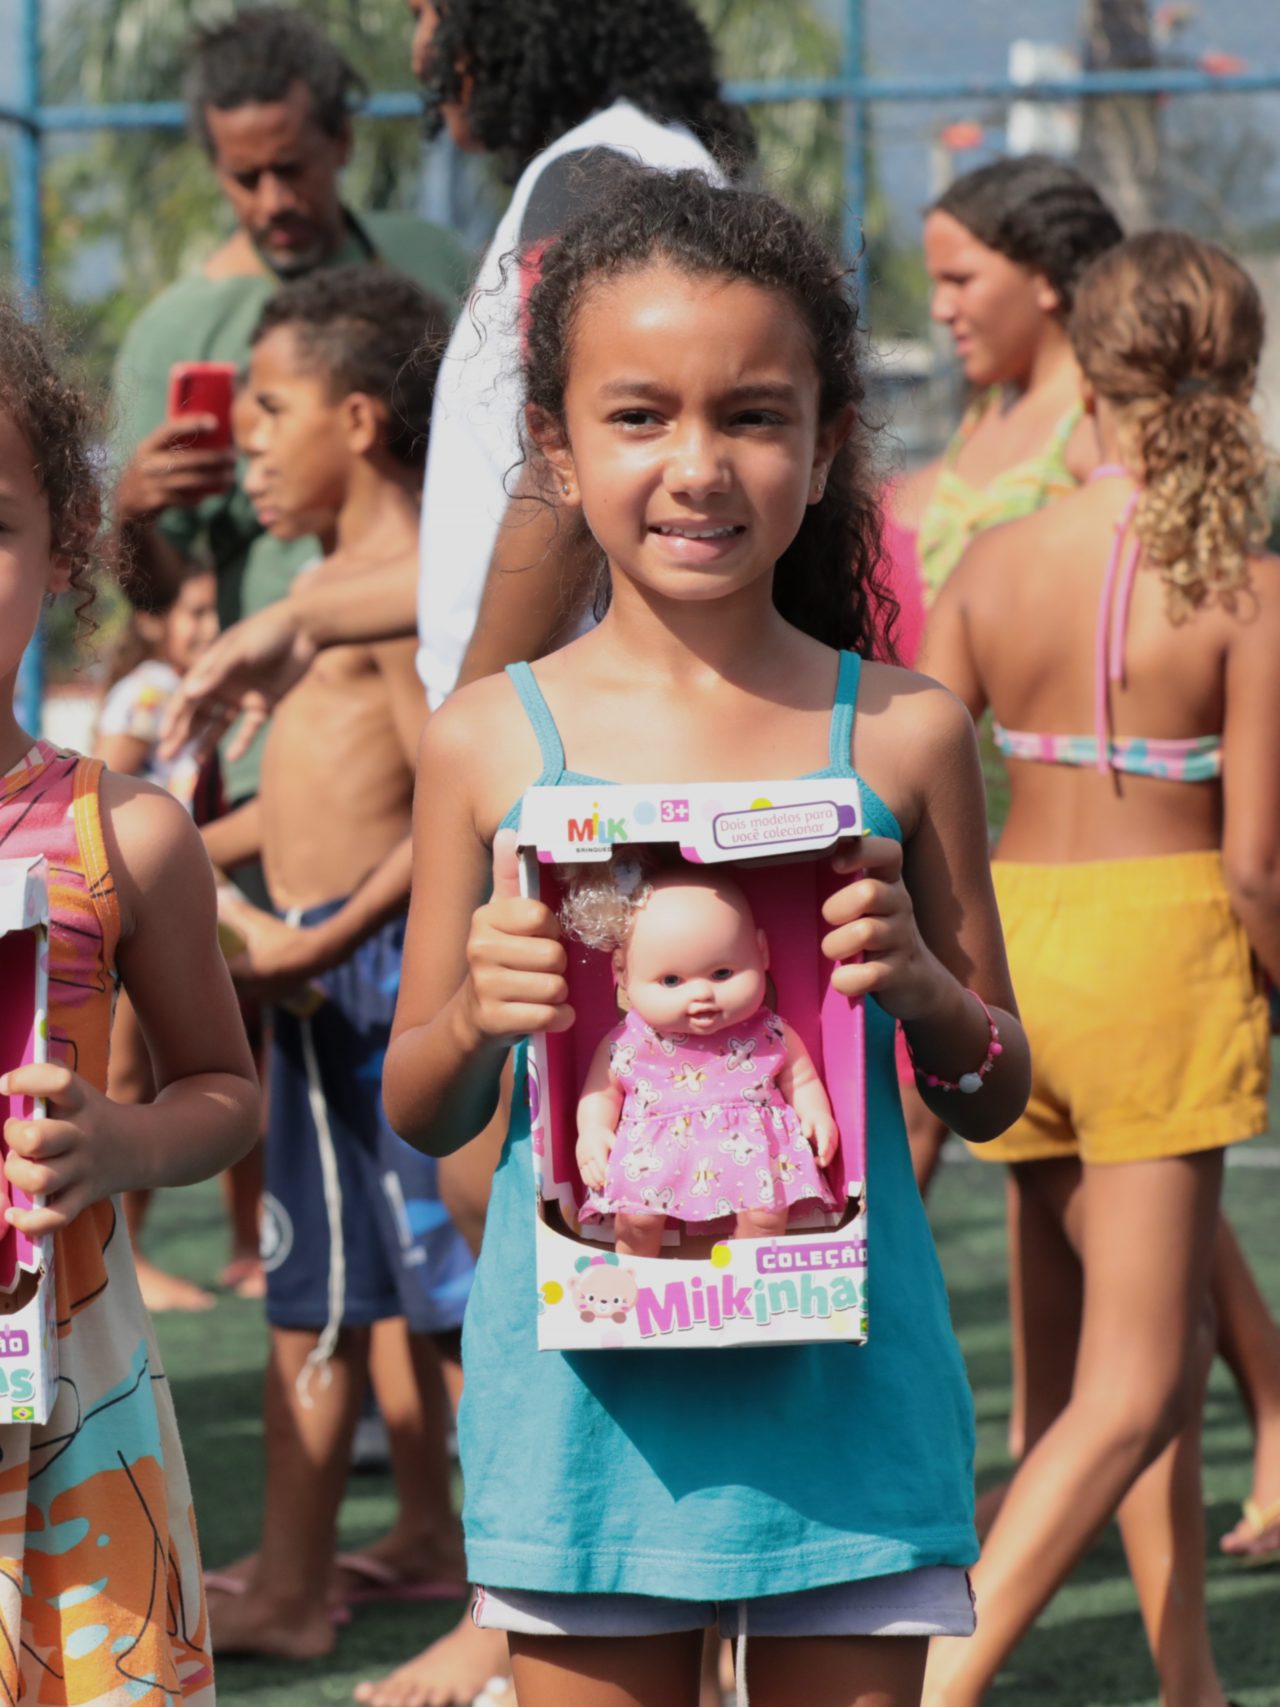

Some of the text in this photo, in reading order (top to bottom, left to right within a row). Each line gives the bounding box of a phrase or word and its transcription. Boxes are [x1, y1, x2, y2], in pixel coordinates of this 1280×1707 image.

[661, 801, 689, 821] 3+
[720, 811, 833, 832] Dois modelos para
[732, 822, 824, 841] você colecionar
